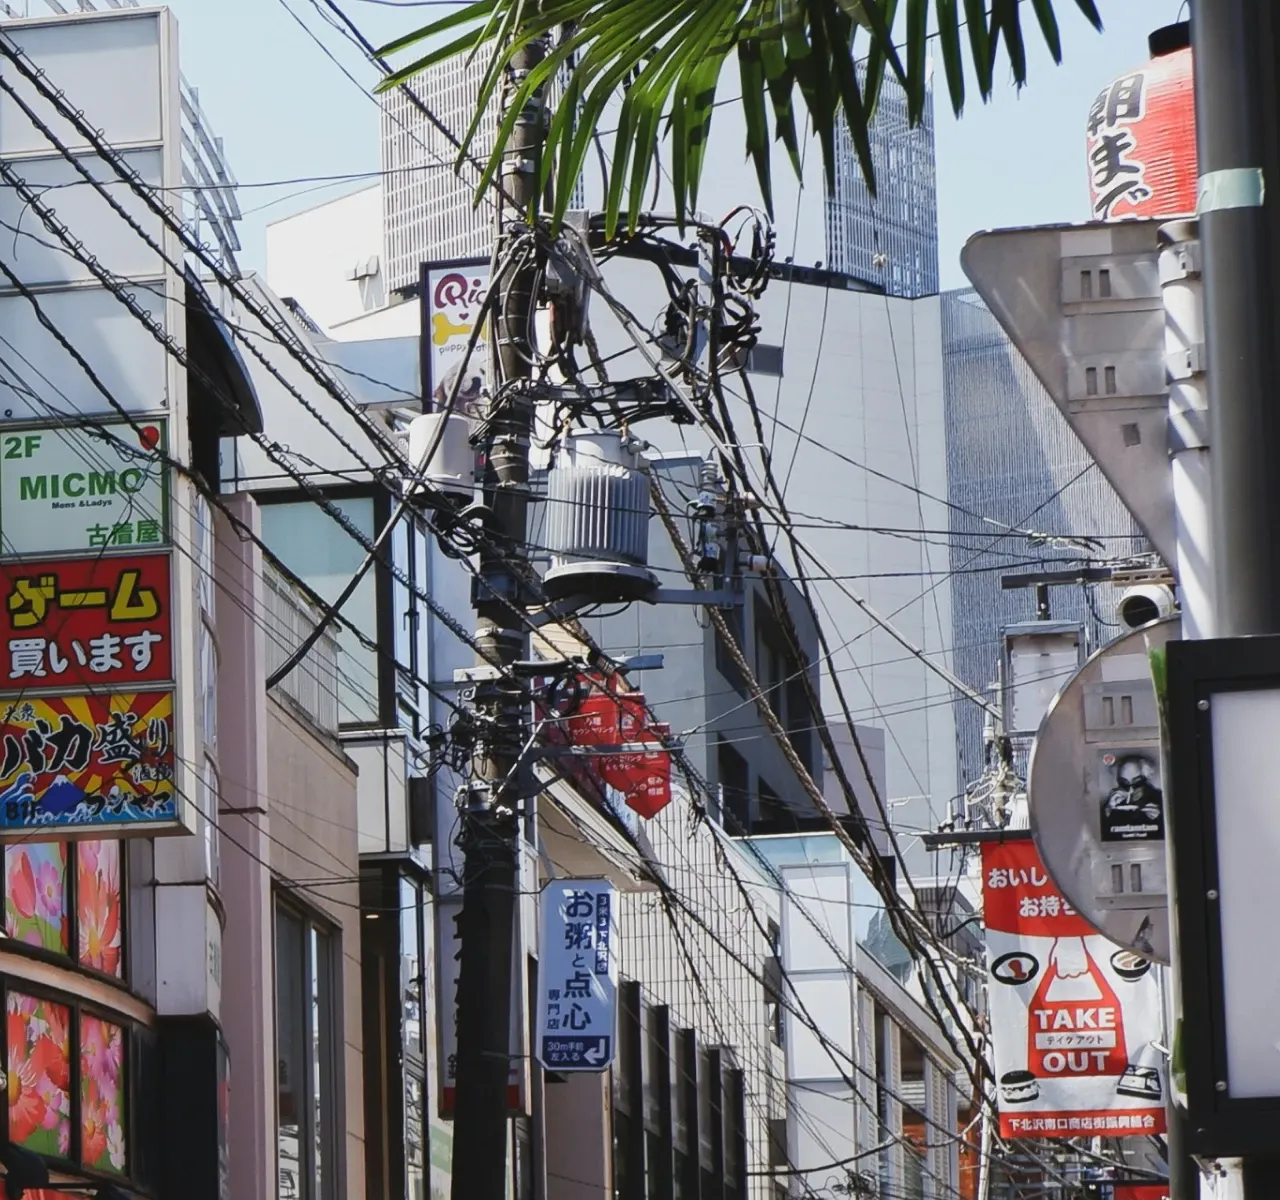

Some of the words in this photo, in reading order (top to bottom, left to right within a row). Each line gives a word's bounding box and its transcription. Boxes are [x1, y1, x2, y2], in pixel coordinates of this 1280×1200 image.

[4, 435, 42, 460] 2F
[20, 468, 144, 501] MICMO
[85, 519, 162, 549] 古着屋
[7, 567, 160, 629] ゲーム
[8, 630, 163, 679] 買います
[562, 890, 594, 1031] お粥と点心
[546, 988, 561, 1030] 専門店
[1034, 1007, 1116, 1030] TAKE
[1047, 1034, 1104, 1046] テイクアウト
[1043, 1051, 1110, 1073] OUT
